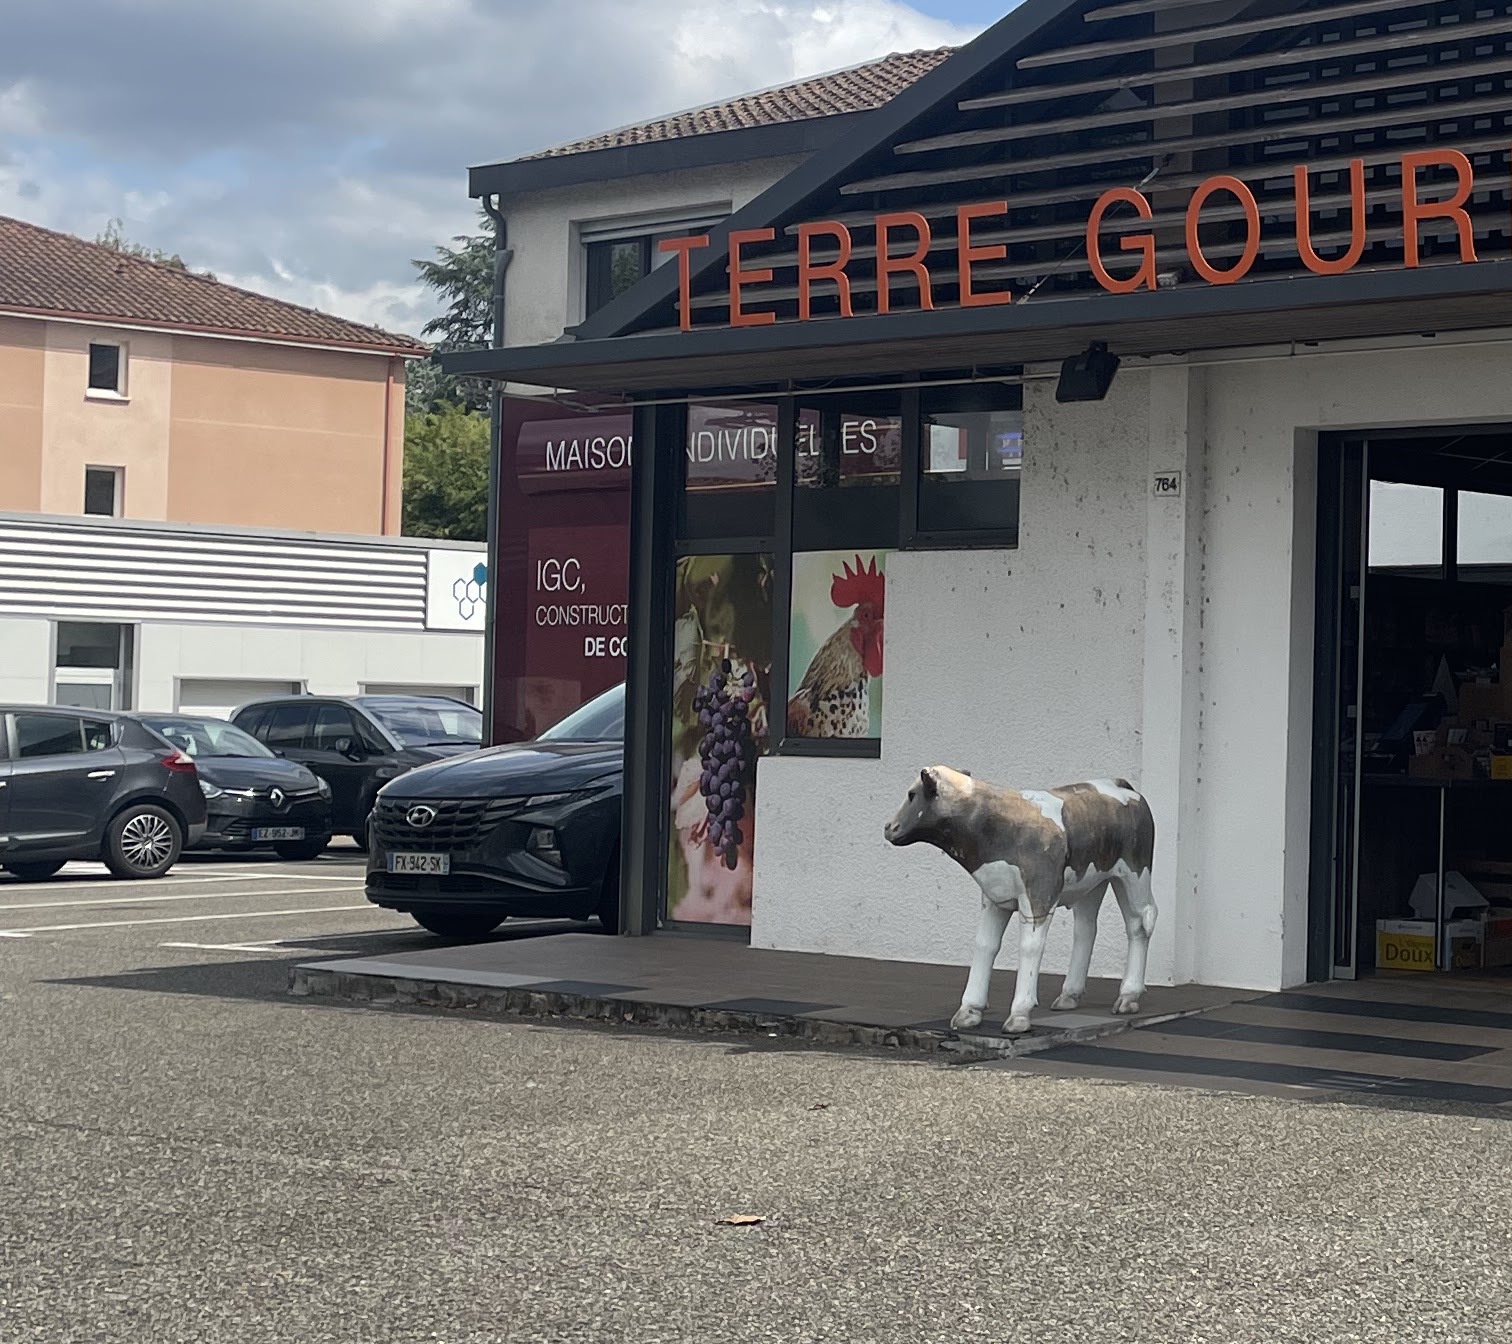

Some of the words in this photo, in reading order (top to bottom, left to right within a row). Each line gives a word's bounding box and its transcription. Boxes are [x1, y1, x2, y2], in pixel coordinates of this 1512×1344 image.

[658, 200, 1011, 333] TERRE
[536, 558, 586, 594] IGC,
[584, 636, 606, 657] DE
[1385, 943, 1433, 964] Doux
